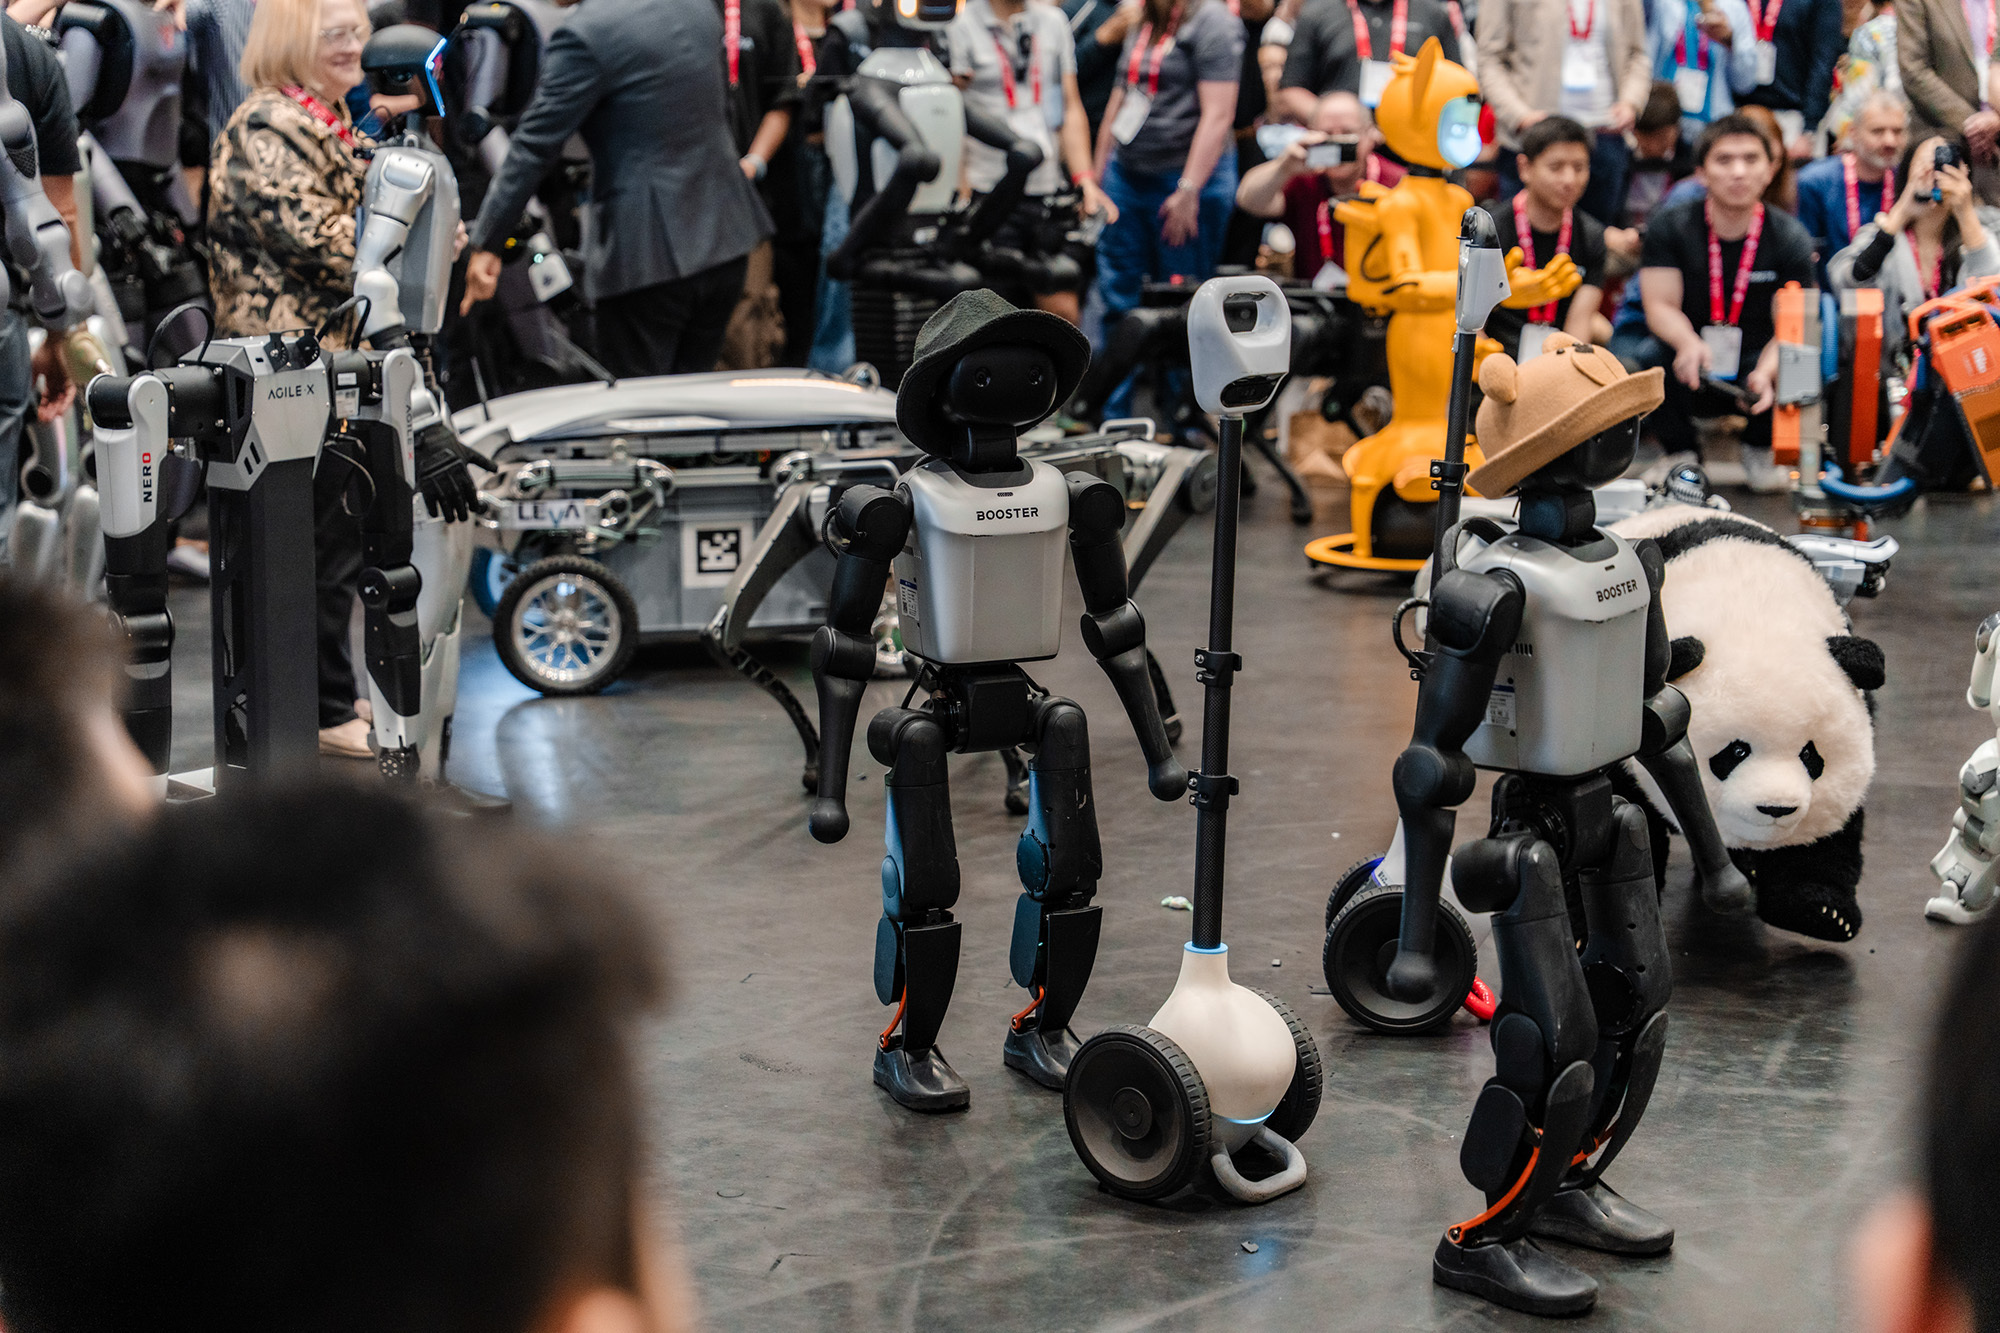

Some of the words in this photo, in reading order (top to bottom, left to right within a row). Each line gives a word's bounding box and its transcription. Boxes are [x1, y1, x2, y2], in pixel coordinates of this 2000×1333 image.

[142, 452, 152, 503] NERO
[518, 502, 580, 529] LEVA
[976, 507, 1039, 521] BOOSTER
[1596, 579, 1638, 602] BOOSTER
